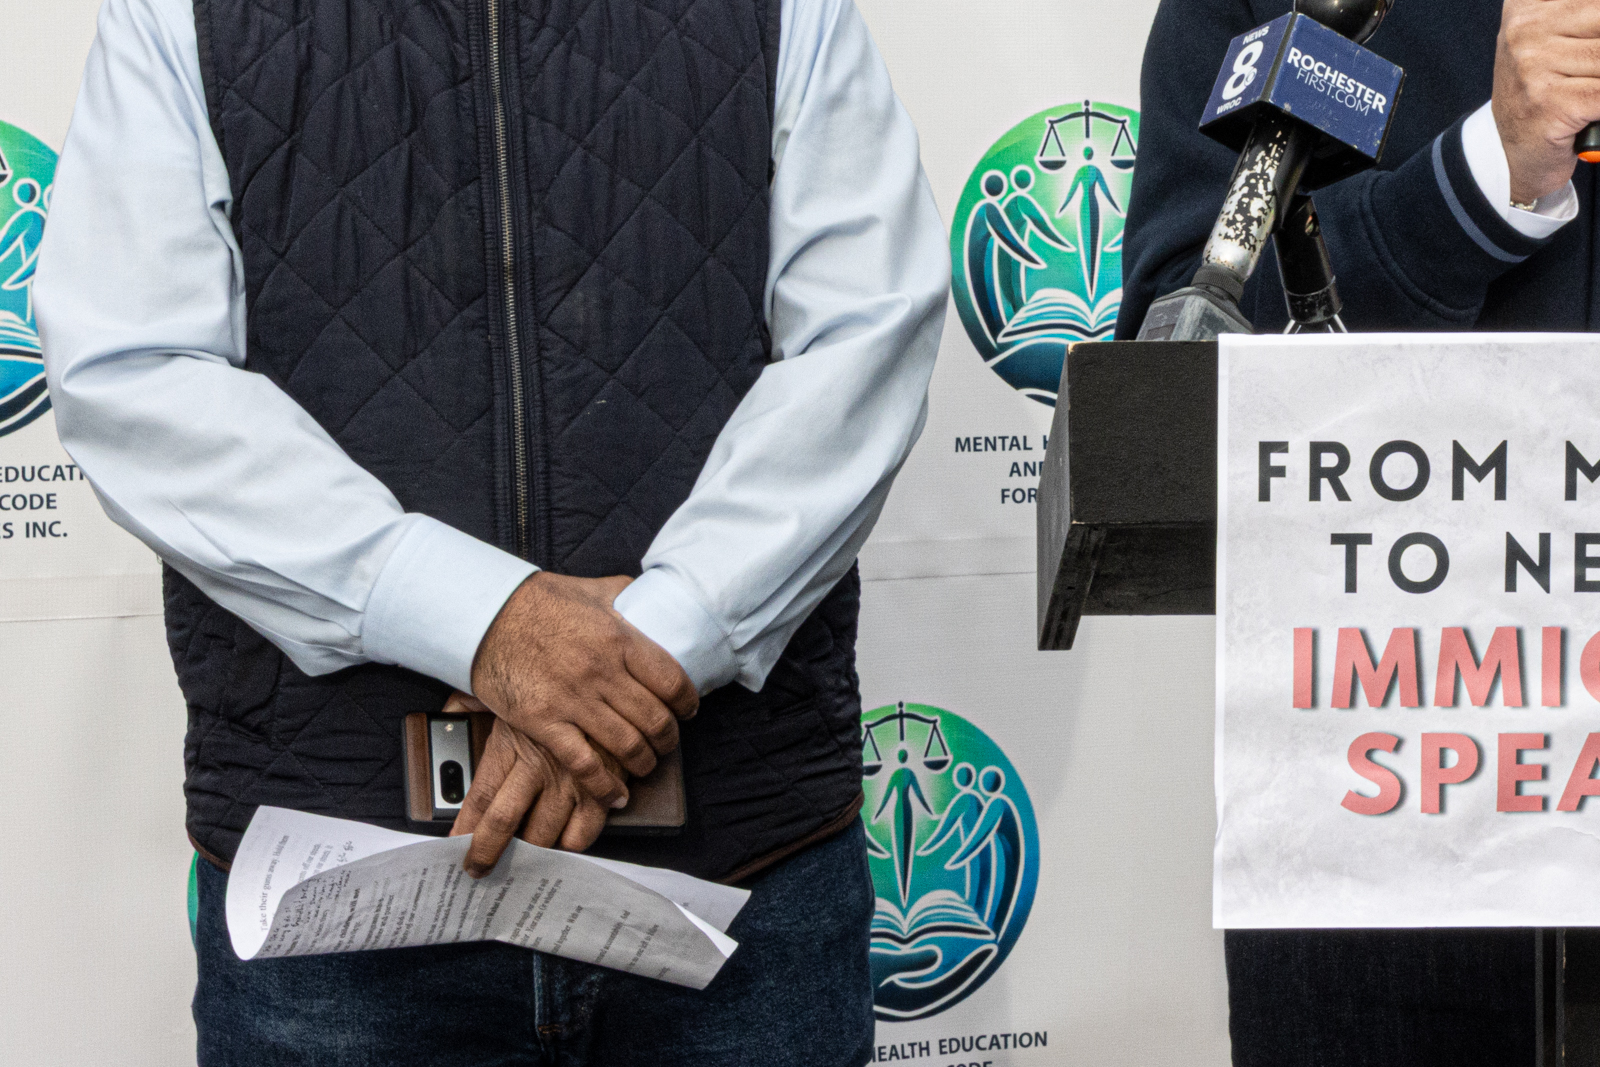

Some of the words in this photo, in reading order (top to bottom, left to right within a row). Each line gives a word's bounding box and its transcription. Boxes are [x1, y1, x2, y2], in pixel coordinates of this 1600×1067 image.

[1242, 25, 1270, 45] NEWS
[1222, 40, 1264, 101] 8
[1287, 47, 1387, 114] ROCHESTER
[1296, 68, 1370, 117] FIRST.COM
[1216, 96, 1242, 114] WROC
[955, 436, 1032, 452] MENTAL
[0, 464, 84, 482] DUCATI
[1259, 440, 1507, 502] FROM
[0, 493, 57, 510] CODE
[1001, 488, 1037, 504] FOR
[26, 521, 67, 538] INC.
[1331, 532, 1449, 594] TO
[259, 893, 268, 911] their
[939, 1032, 1047, 1055] EDUCATION
